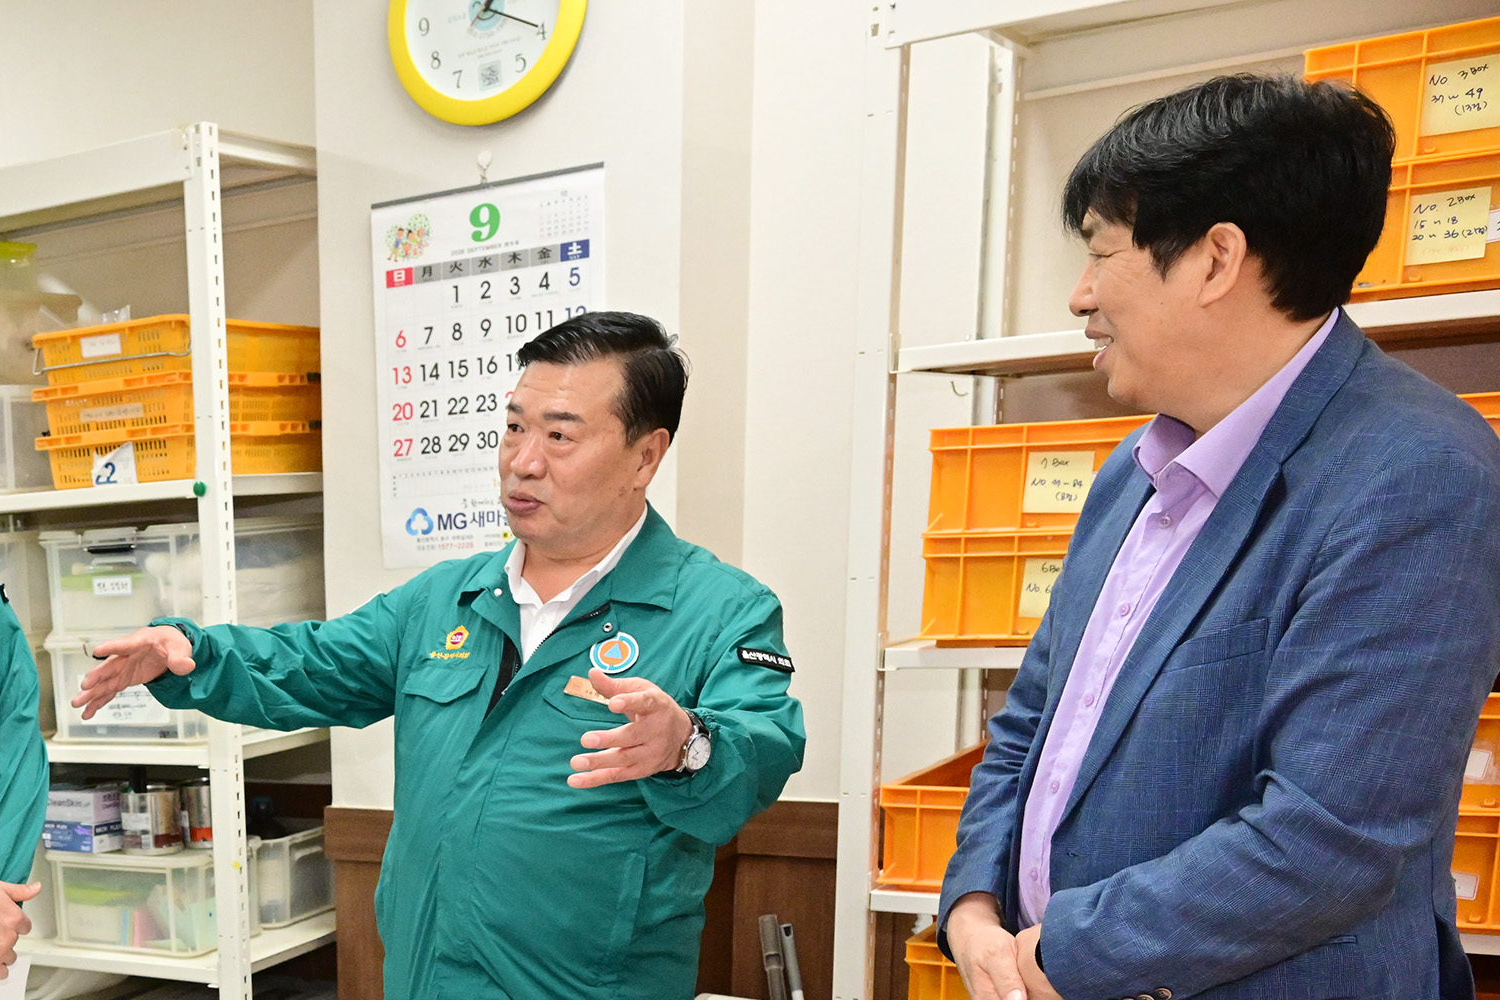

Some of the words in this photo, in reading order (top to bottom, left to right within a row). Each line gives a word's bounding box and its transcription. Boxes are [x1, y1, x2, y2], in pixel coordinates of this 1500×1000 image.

[418, 18, 430, 36] 9
[536, 22, 546, 40] 4
[430, 51, 442, 70] 8
[516, 53, 526, 73] 5
[452, 70, 463, 88] 7
[1465, 88, 1483, 98] 49
[469, 202, 500, 242] 9
[394, 270, 406, 282] 日
[422, 266, 432, 278] 月
[450, 262, 464, 273] 火
[478, 257, 492, 268] 水
[508, 252, 522, 264] 木
[537, 247, 552, 260] 金
[567, 242, 582, 255] 土
[452, 286, 458, 302] 1
[481, 281, 491, 299] 2
[510, 276, 520, 295] 3
[539, 272, 550, 290] 4
[569, 267, 580, 286] 5
[396, 330, 406, 348] 6
[424, 327, 434, 344] 7
[452, 324, 462, 340] 8
[480, 319, 492, 337] 9
[506, 314, 527, 333] 10
[536, 310, 554, 330] 11
[392, 366, 412, 385] 13
[420, 363, 440, 382] 14
[448, 360, 468, 378] 15
[477, 356, 498, 375] 16
[392, 402, 413, 421] 20
[420, 400, 438, 418] 21
[448, 397, 469, 416] 22
[476, 394, 497, 412] 23
[393, 439, 413, 458] 27
[421, 436, 442, 455] 28
[448, 434, 470, 452] 29
[476, 431, 498, 450] 30
[438, 512, 466, 530] MG
[742, 650, 777, 664] 울산광역시
